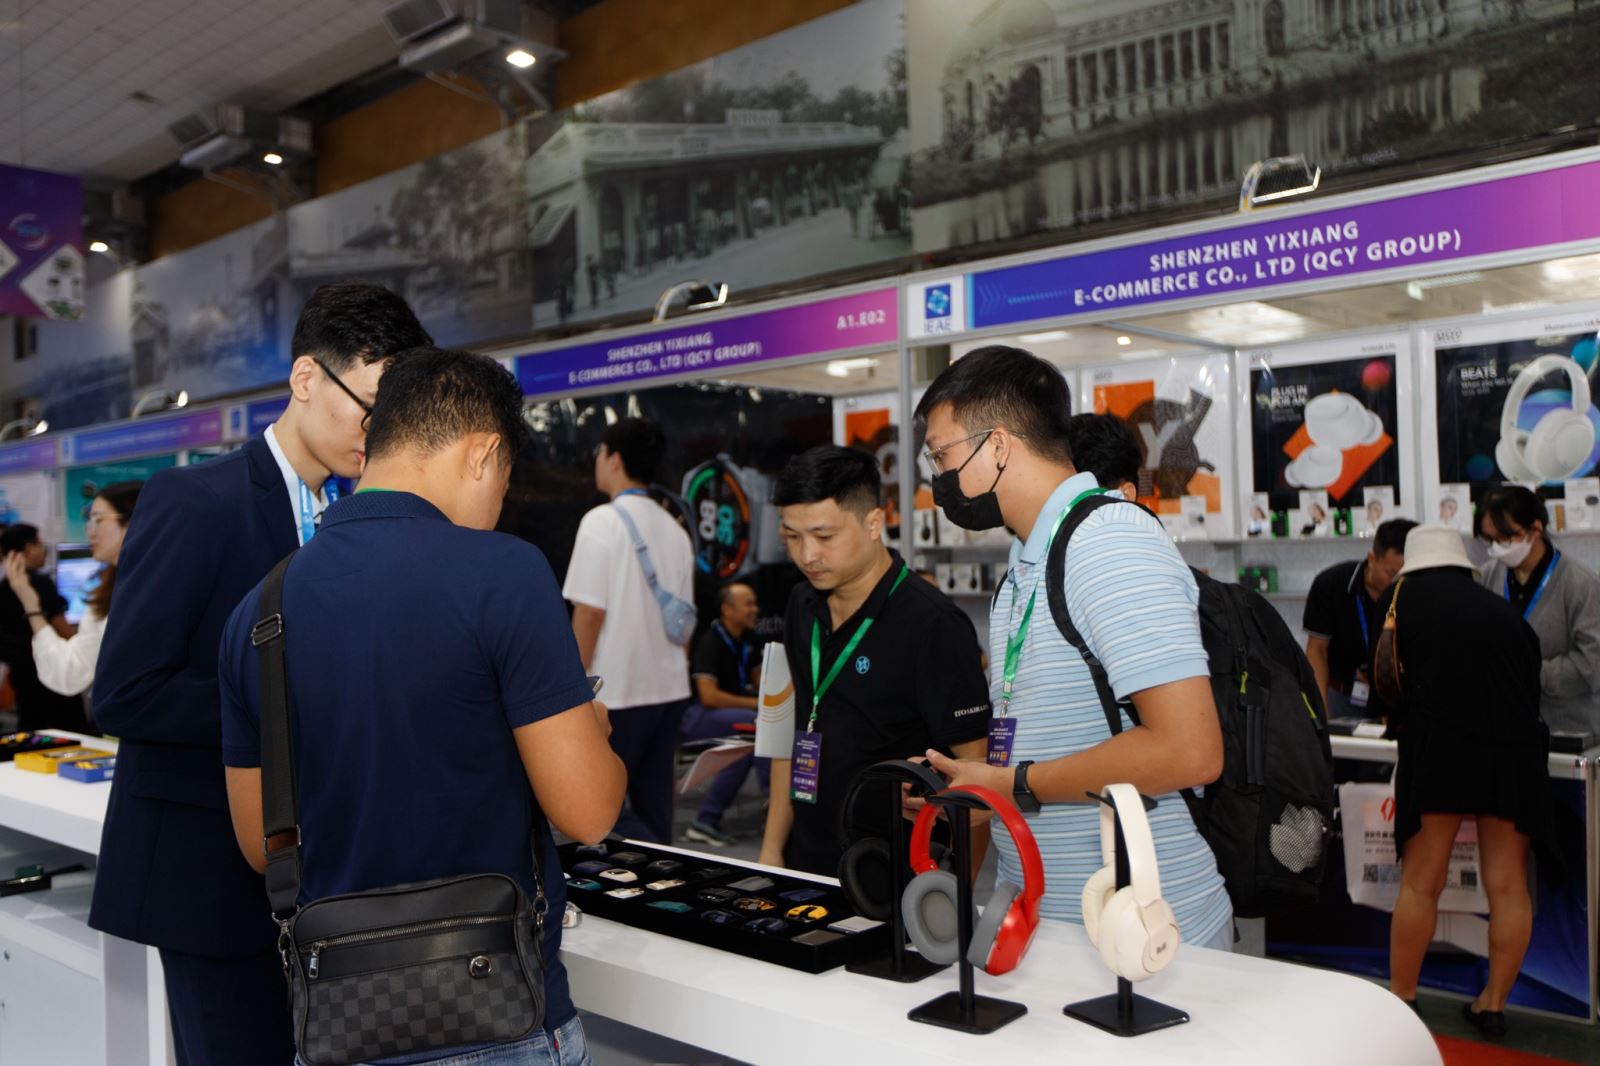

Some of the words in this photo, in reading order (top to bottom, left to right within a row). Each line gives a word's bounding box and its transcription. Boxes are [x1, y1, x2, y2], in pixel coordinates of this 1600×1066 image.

[1150, 238, 1257, 272] SHENZHEN
[1264, 221, 1358, 253] YIXIANG
[1074, 271, 1199, 306] E-COMMERCE
[1205, 266, 1248, 286] CO.,
[1255, 256, 1296, 279] LTD
[1303, 246, 1358, 273] (QCY
[1367, 229, 1461, 261] GROUP)
[836, 309, 886, 330] A1.E02
[607, 340, 664, 362] SHENZHEN
[664, 331, 714, 351] YIXIANG
[660, 353, 683, 370] LTD
[684, 349, 711, 367] (QCY
[714, 341, 762, 361] GROUP)
[1460, 365, 1498, 381] BEATS
